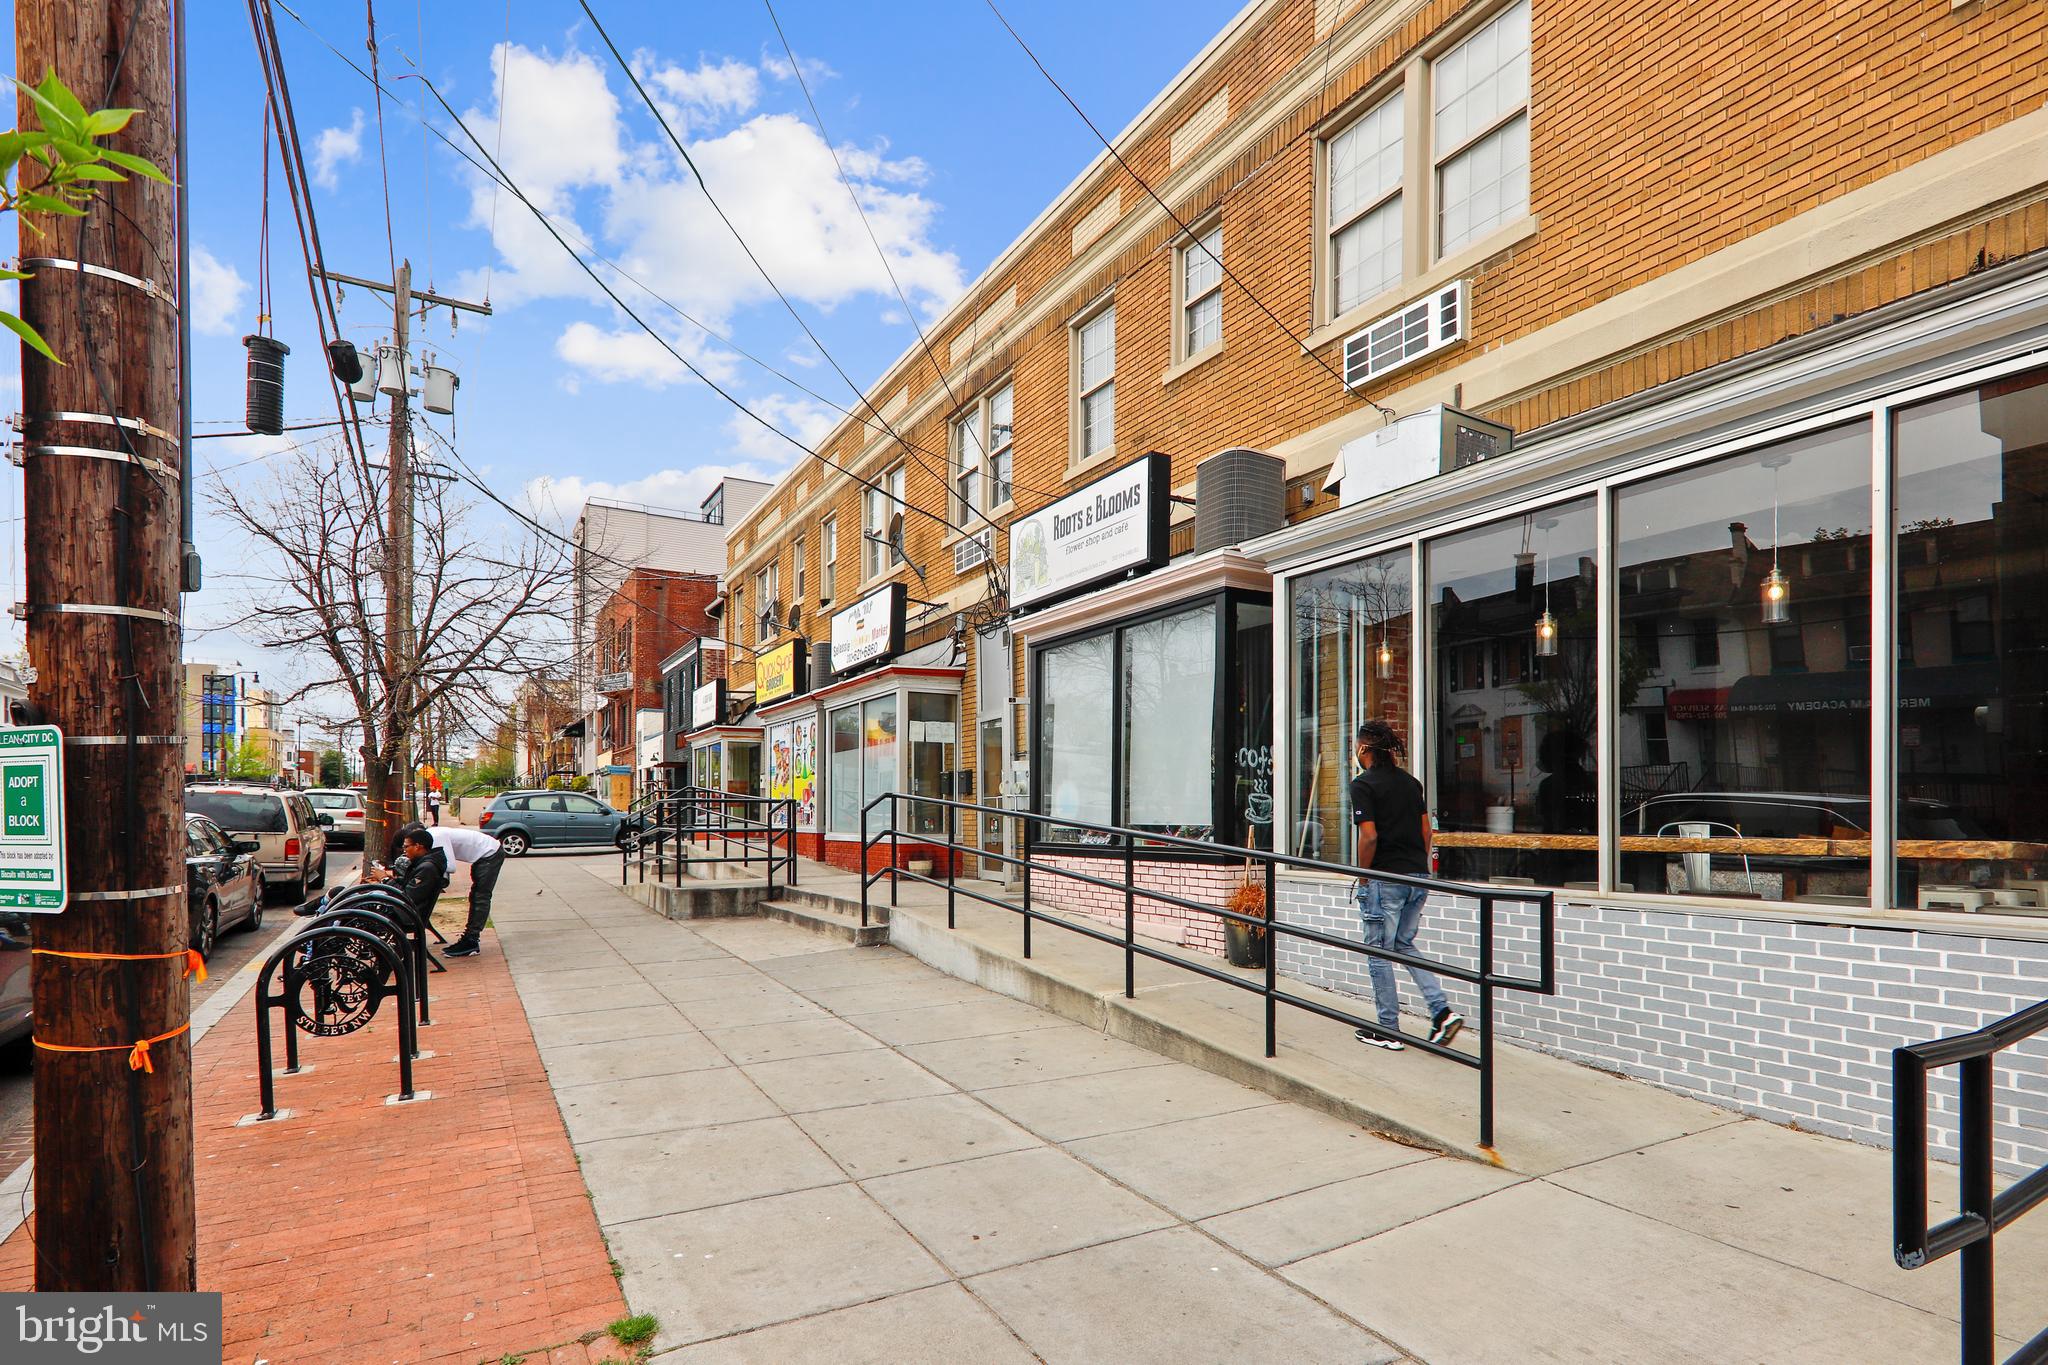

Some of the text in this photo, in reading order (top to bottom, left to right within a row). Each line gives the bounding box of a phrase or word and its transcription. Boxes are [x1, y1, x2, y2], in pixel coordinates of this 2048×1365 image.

[1053, 483, 1141, 541] ROOTS & BLOOMS
[1065, 540, 1084, 556] flower
[1085, 534, 1101, 548] shop
[1101, 529, 1113, 541] and
[42, 732, 54, 743] DC
[8, 776, 39, 788] ADOPT
[20, 795, 27, 807] a
[8, 814, 40, 827] BLOCK
[351, 1009, 371, 1030] NW
